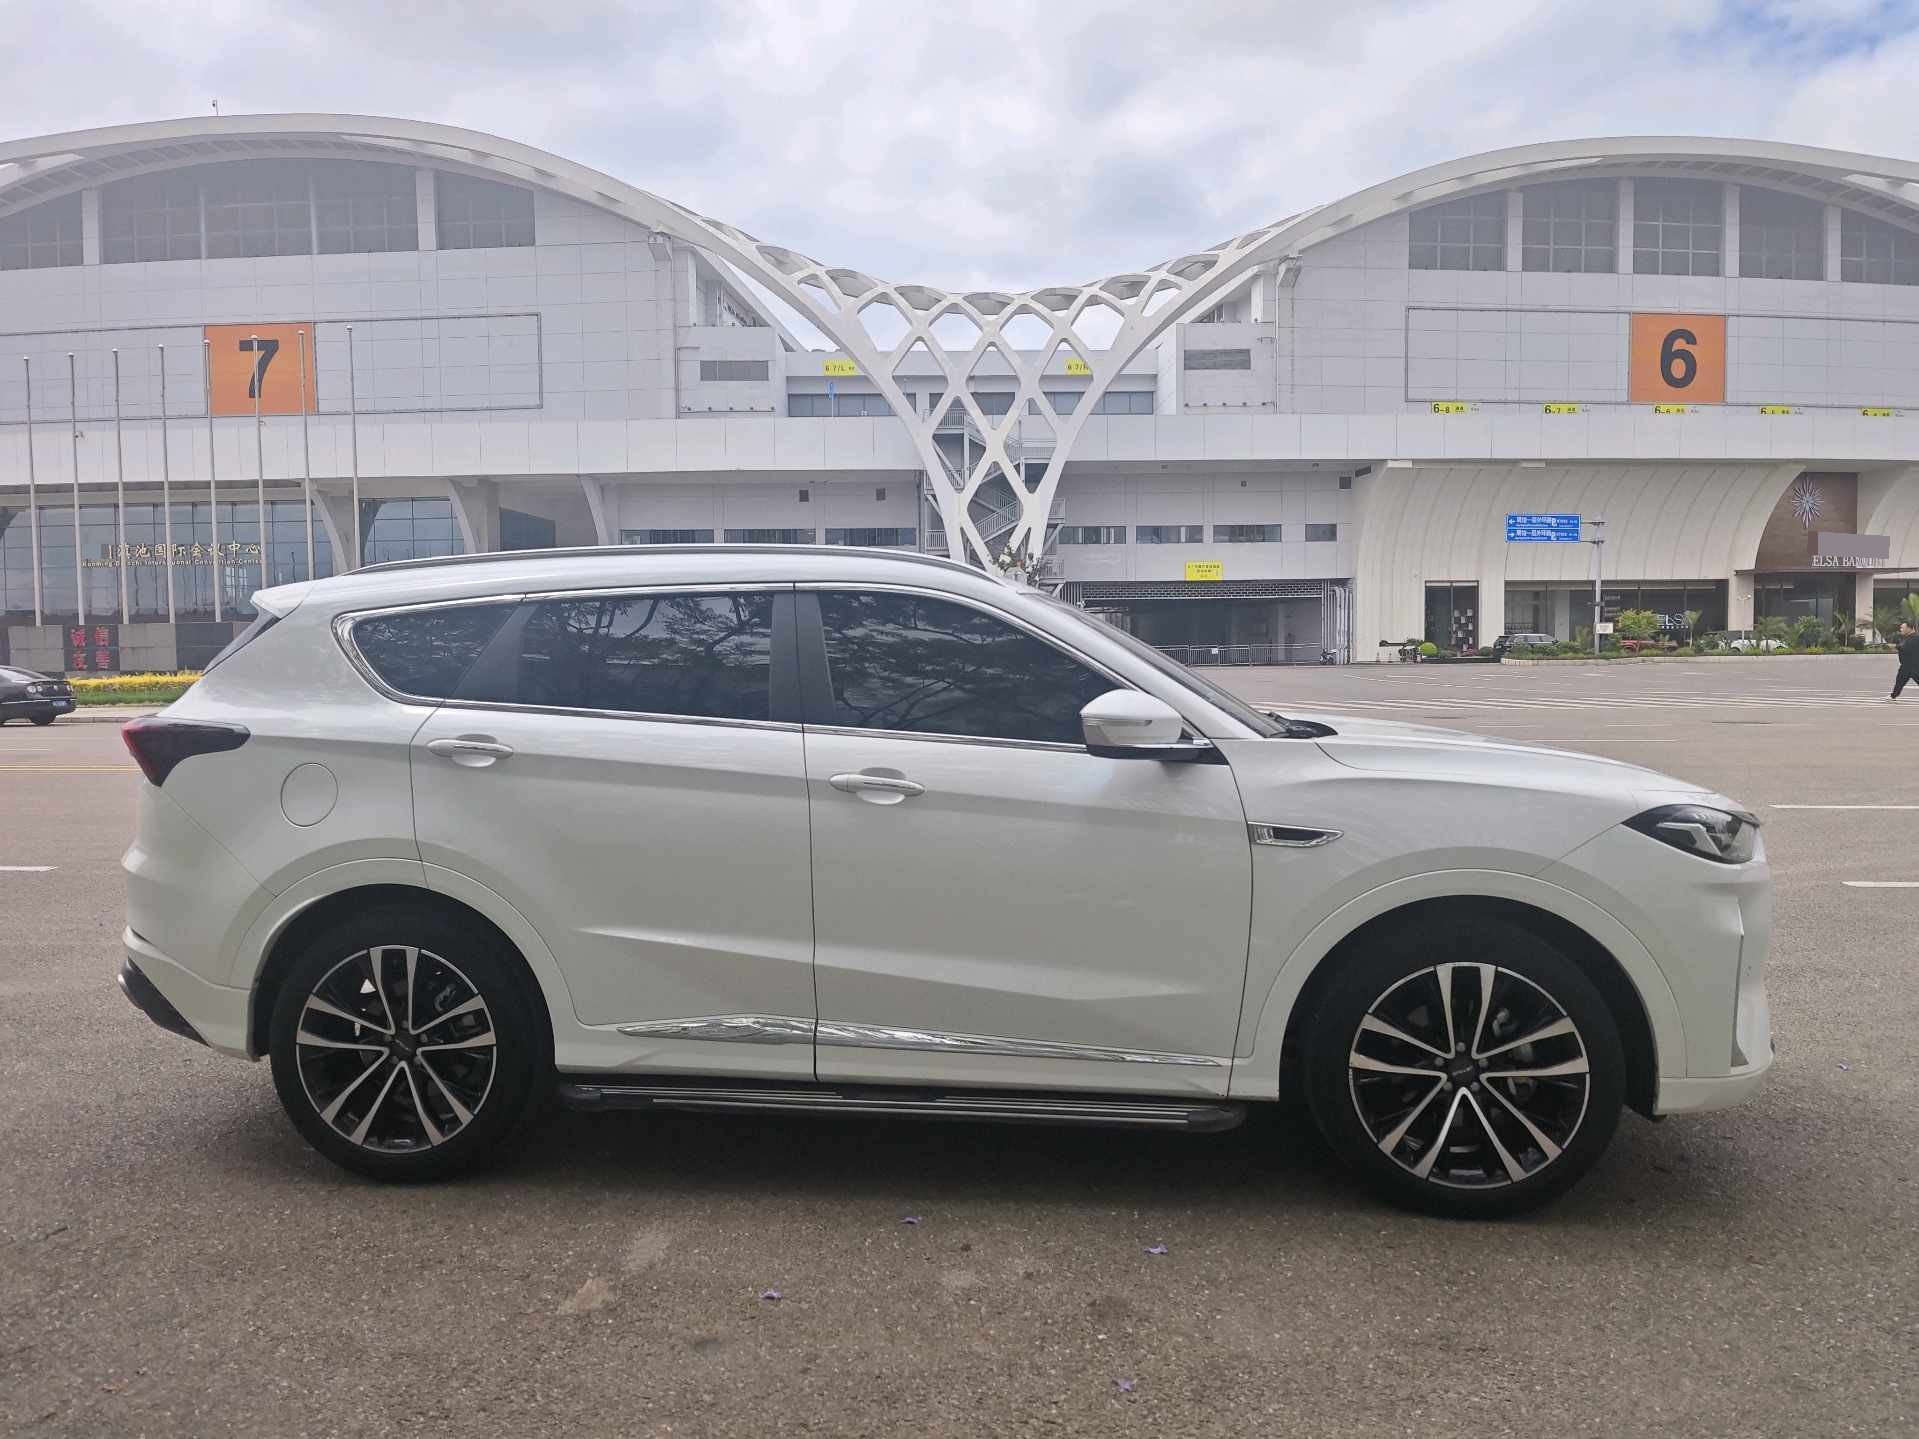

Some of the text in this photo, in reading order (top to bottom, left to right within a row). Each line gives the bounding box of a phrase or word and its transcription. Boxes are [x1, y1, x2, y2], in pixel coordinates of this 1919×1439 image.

[239, 339, 279, 398] 7
[1661, 328, 1697, 388] 6
[1813, 556, 1839, 567] ELSA
